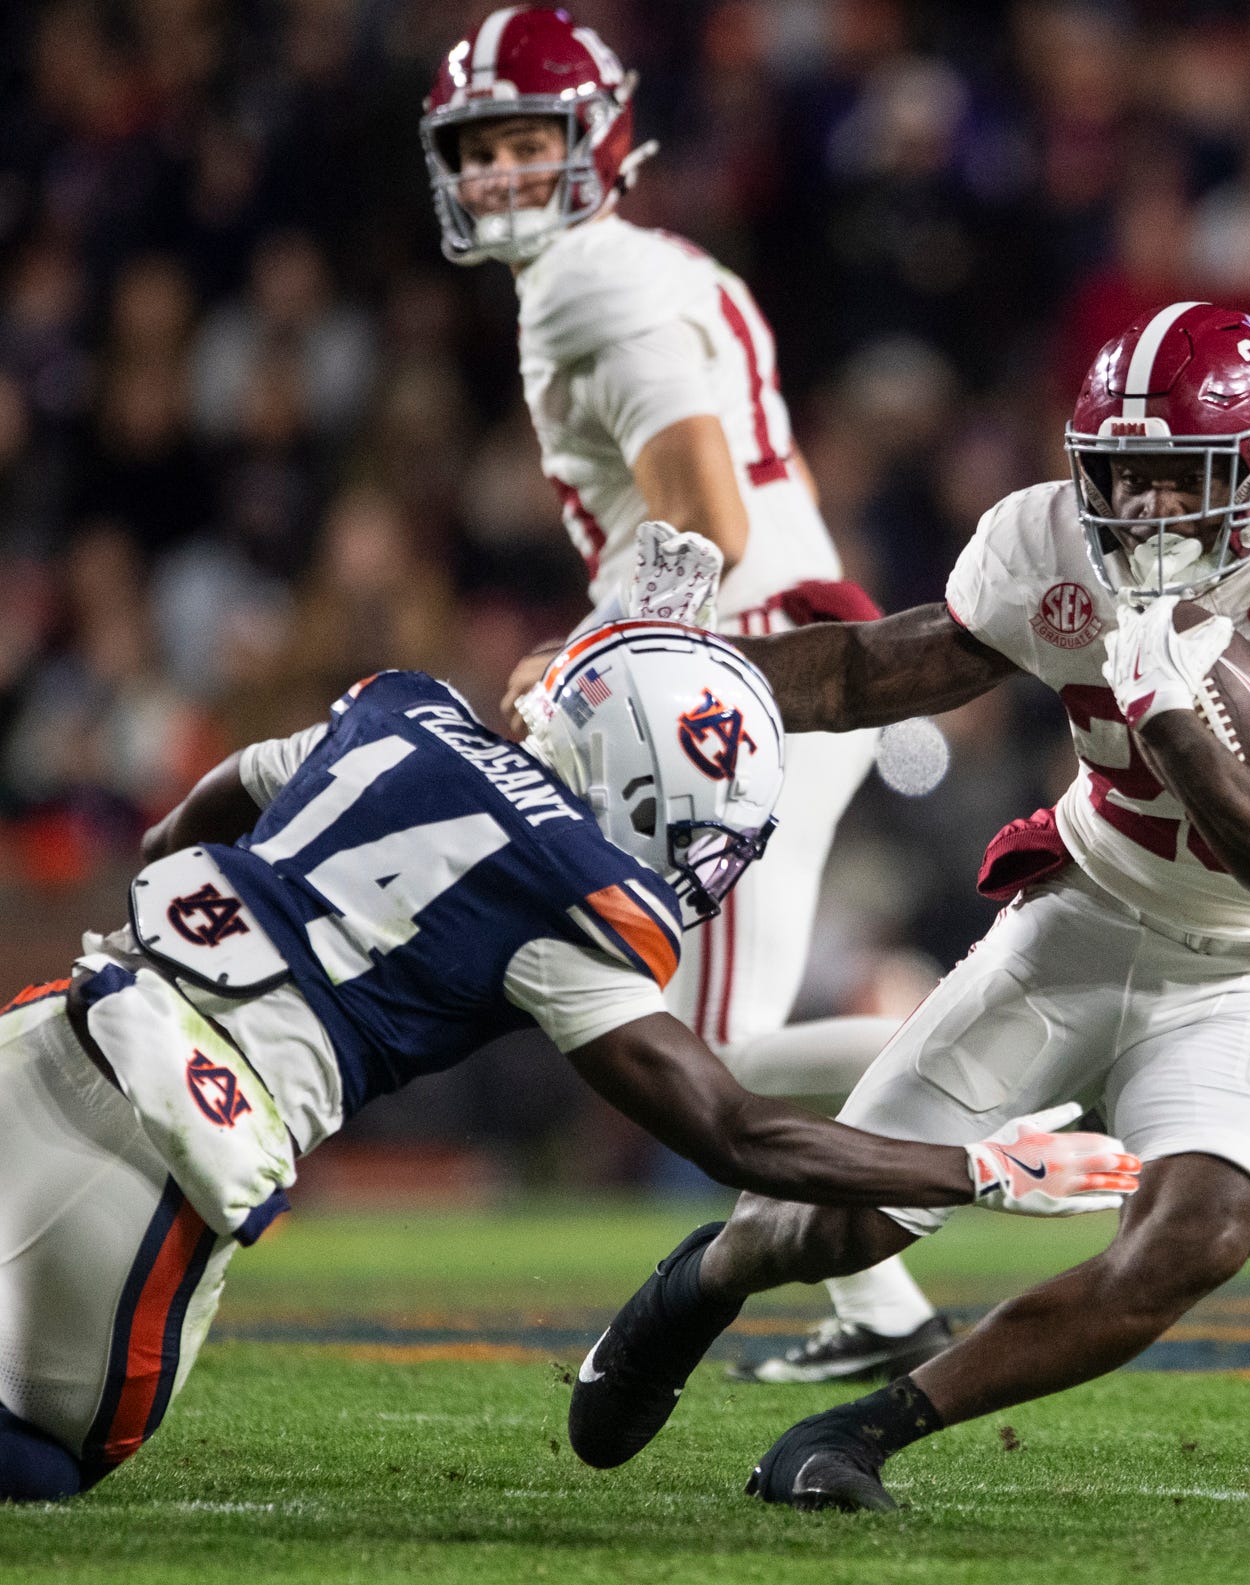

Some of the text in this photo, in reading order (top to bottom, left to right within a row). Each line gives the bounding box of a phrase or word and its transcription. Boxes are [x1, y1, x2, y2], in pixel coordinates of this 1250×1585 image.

[1037, 625, 1095, 648] GRADUATE
[1043, 584, 1090, 632] SEC
[404, 704, 584, 828] PLEASANT
[249, 733, 513, 988] 14
